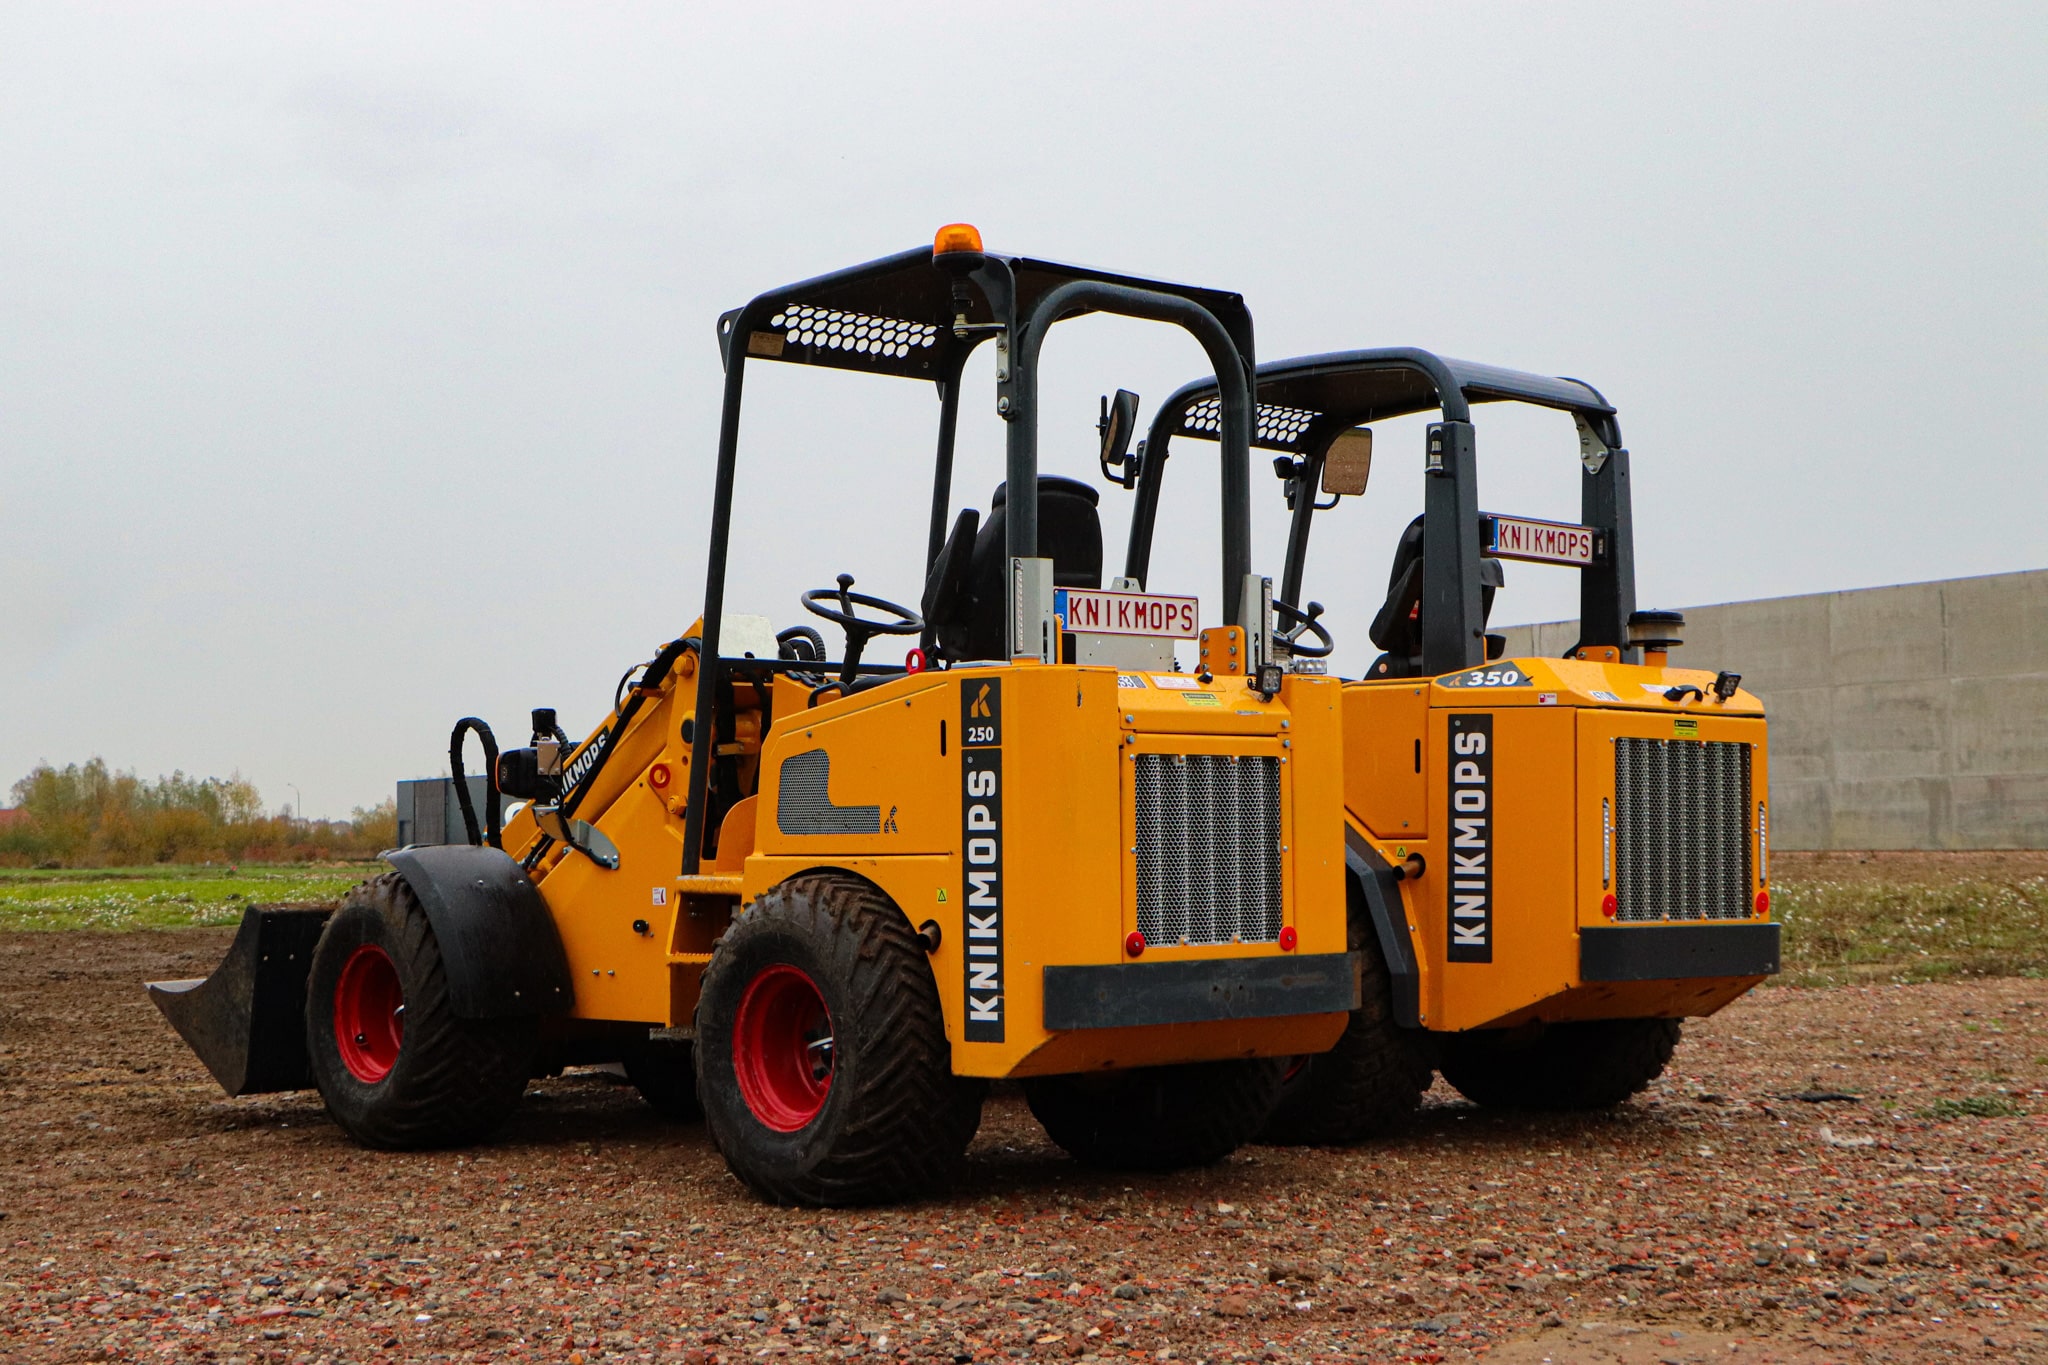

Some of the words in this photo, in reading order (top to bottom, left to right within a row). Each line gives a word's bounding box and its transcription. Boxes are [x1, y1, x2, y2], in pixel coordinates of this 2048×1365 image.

[1499, 523, 1589, 558] KNIKMOPS
[1069, 597, 1193, 631] KNIKMOPS
[1117, 675, 1135, 688] 53
[1467, 670, 1519, 686] 350
[968, 726, 995, 742] 250
[1454, 732, 1486, 945] KNIKMOPS
[968, 770, 999, 1021] KNIKMOPS
